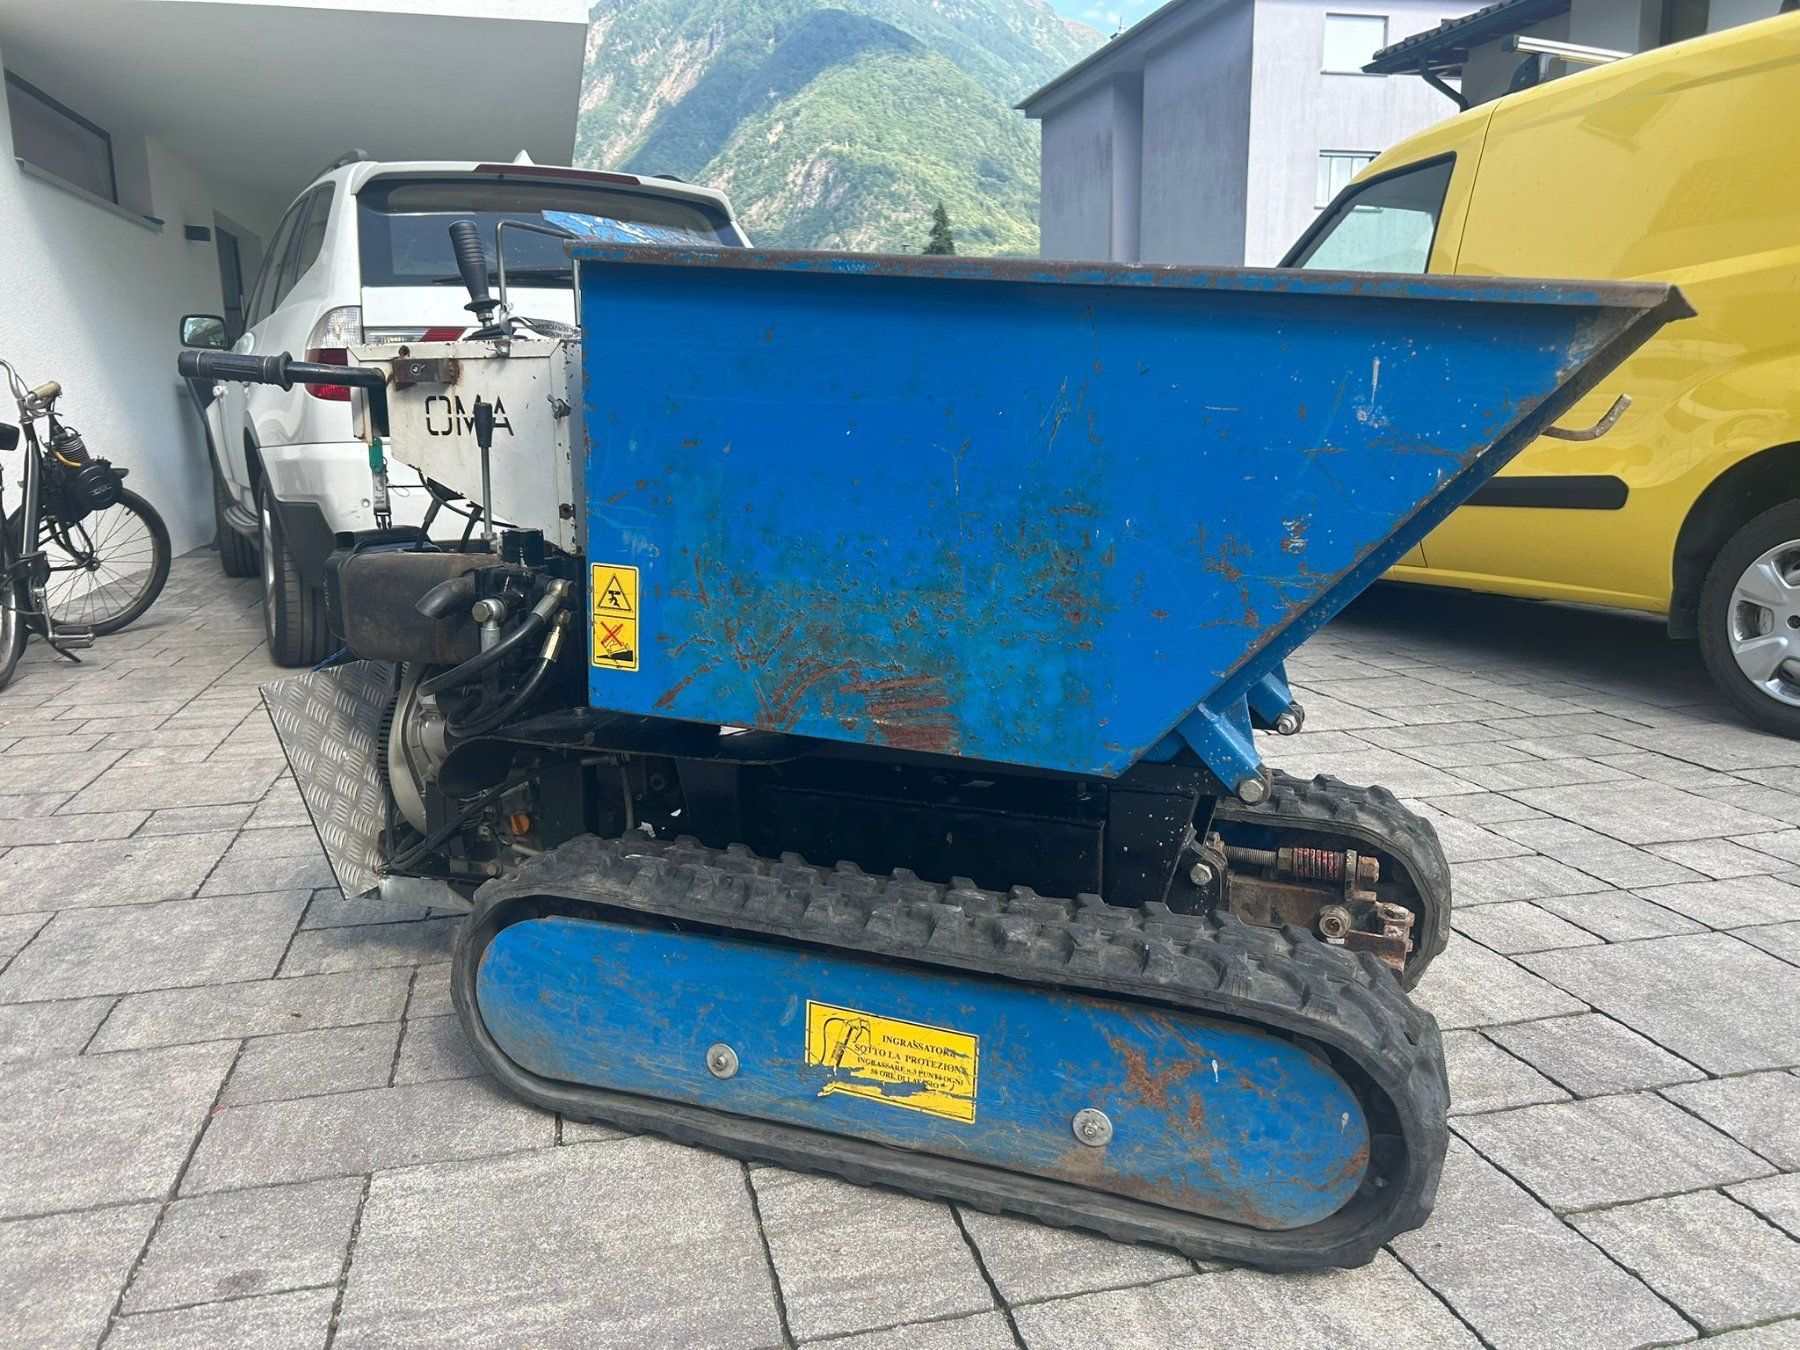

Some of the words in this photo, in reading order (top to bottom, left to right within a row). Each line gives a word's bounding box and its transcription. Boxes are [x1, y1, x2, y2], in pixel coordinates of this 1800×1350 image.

[425, 393, 514, 436] OMA
[854, 1043, 886, 1057] SOTTO
[888, 1051, 901, 1060] LA
[857, 1056, 904, 1073] INGRASSARE
